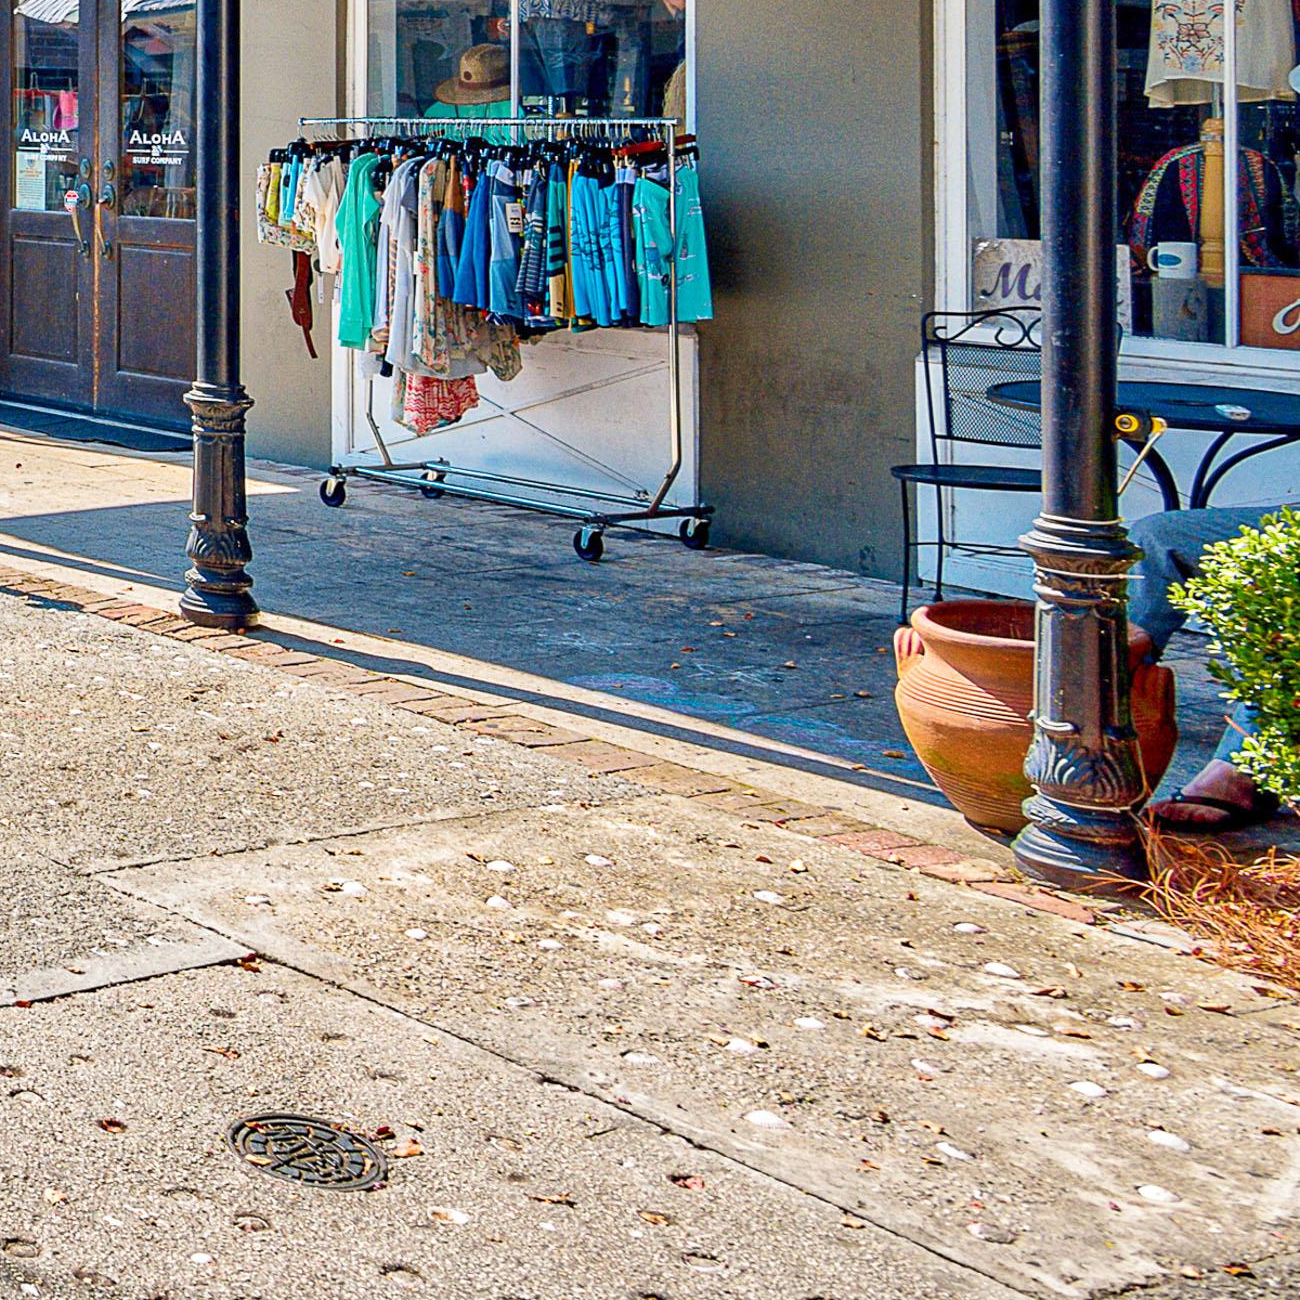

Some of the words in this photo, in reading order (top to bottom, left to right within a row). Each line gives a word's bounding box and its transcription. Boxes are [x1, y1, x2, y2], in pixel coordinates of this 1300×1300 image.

[21, 129, 70, 143] ALOHA
[129, 130, 186, 145] ALOHA
[150, 157, 182, 165] COMPANY
